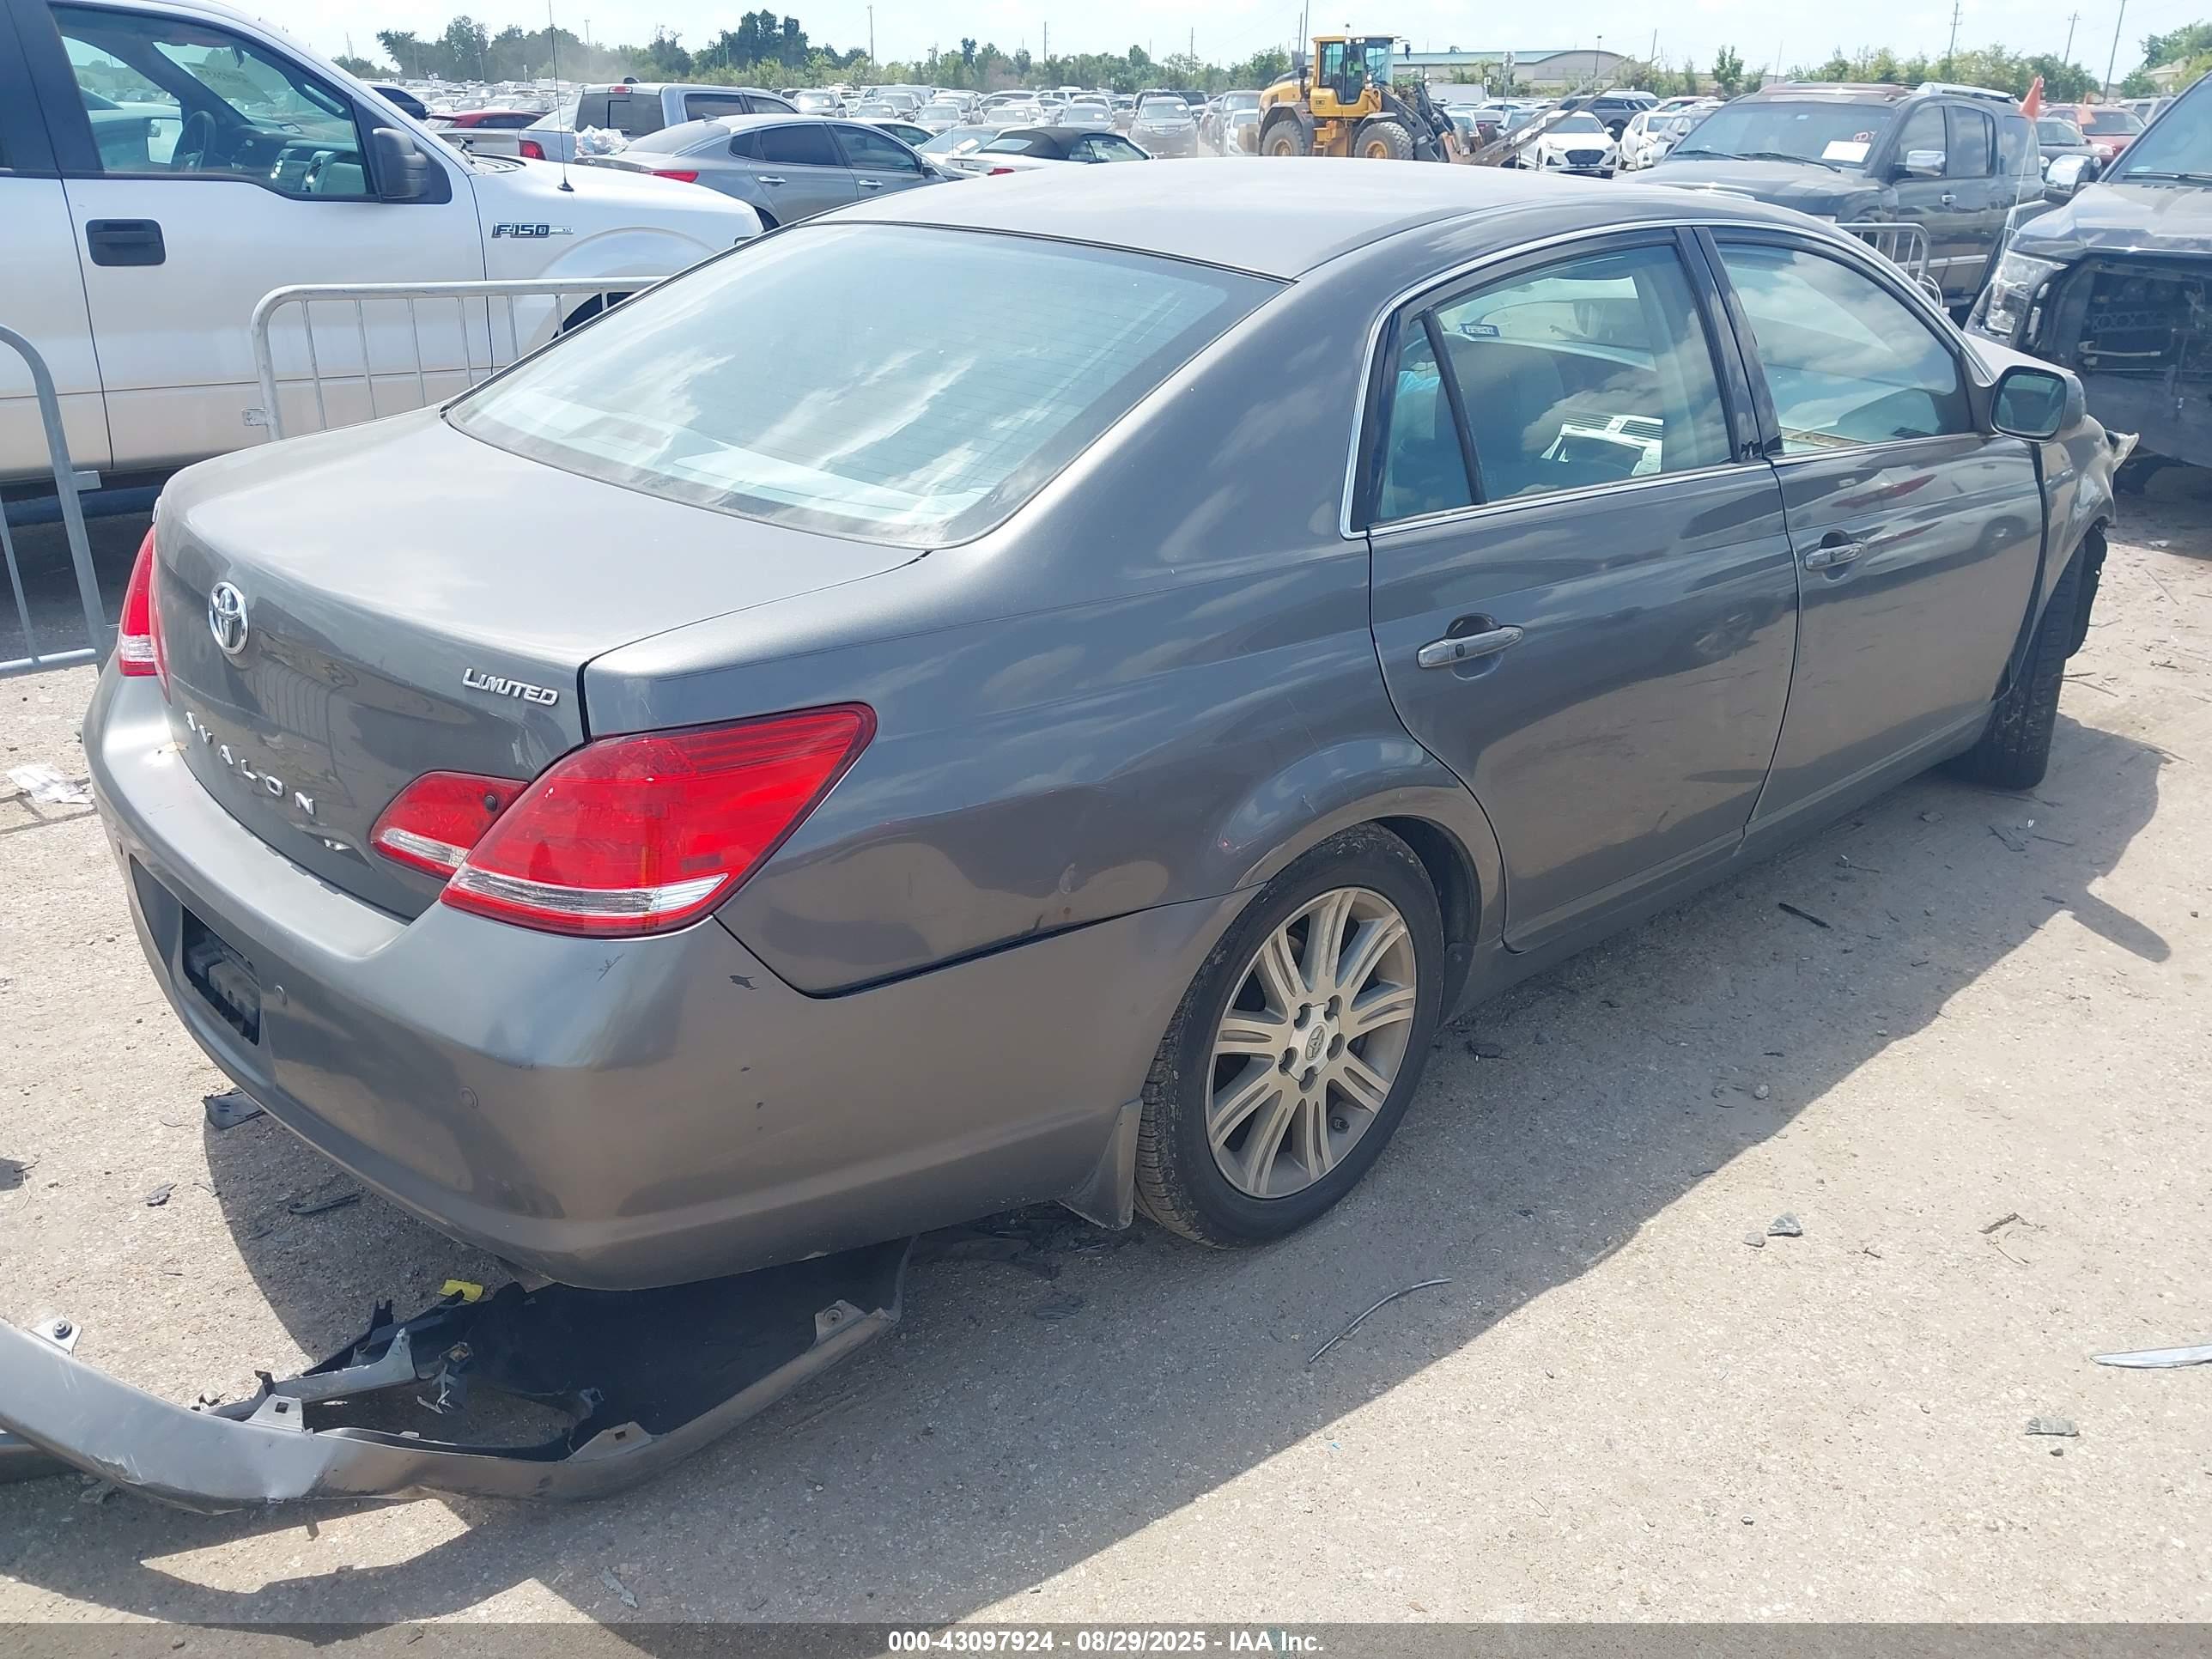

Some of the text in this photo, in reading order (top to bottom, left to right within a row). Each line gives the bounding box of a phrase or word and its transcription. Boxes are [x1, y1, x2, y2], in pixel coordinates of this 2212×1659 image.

[493, 222, 550, 238] F-150
[463, 668, 559, 706] LIMITED
[185, 711, 315, 815] AVALON
